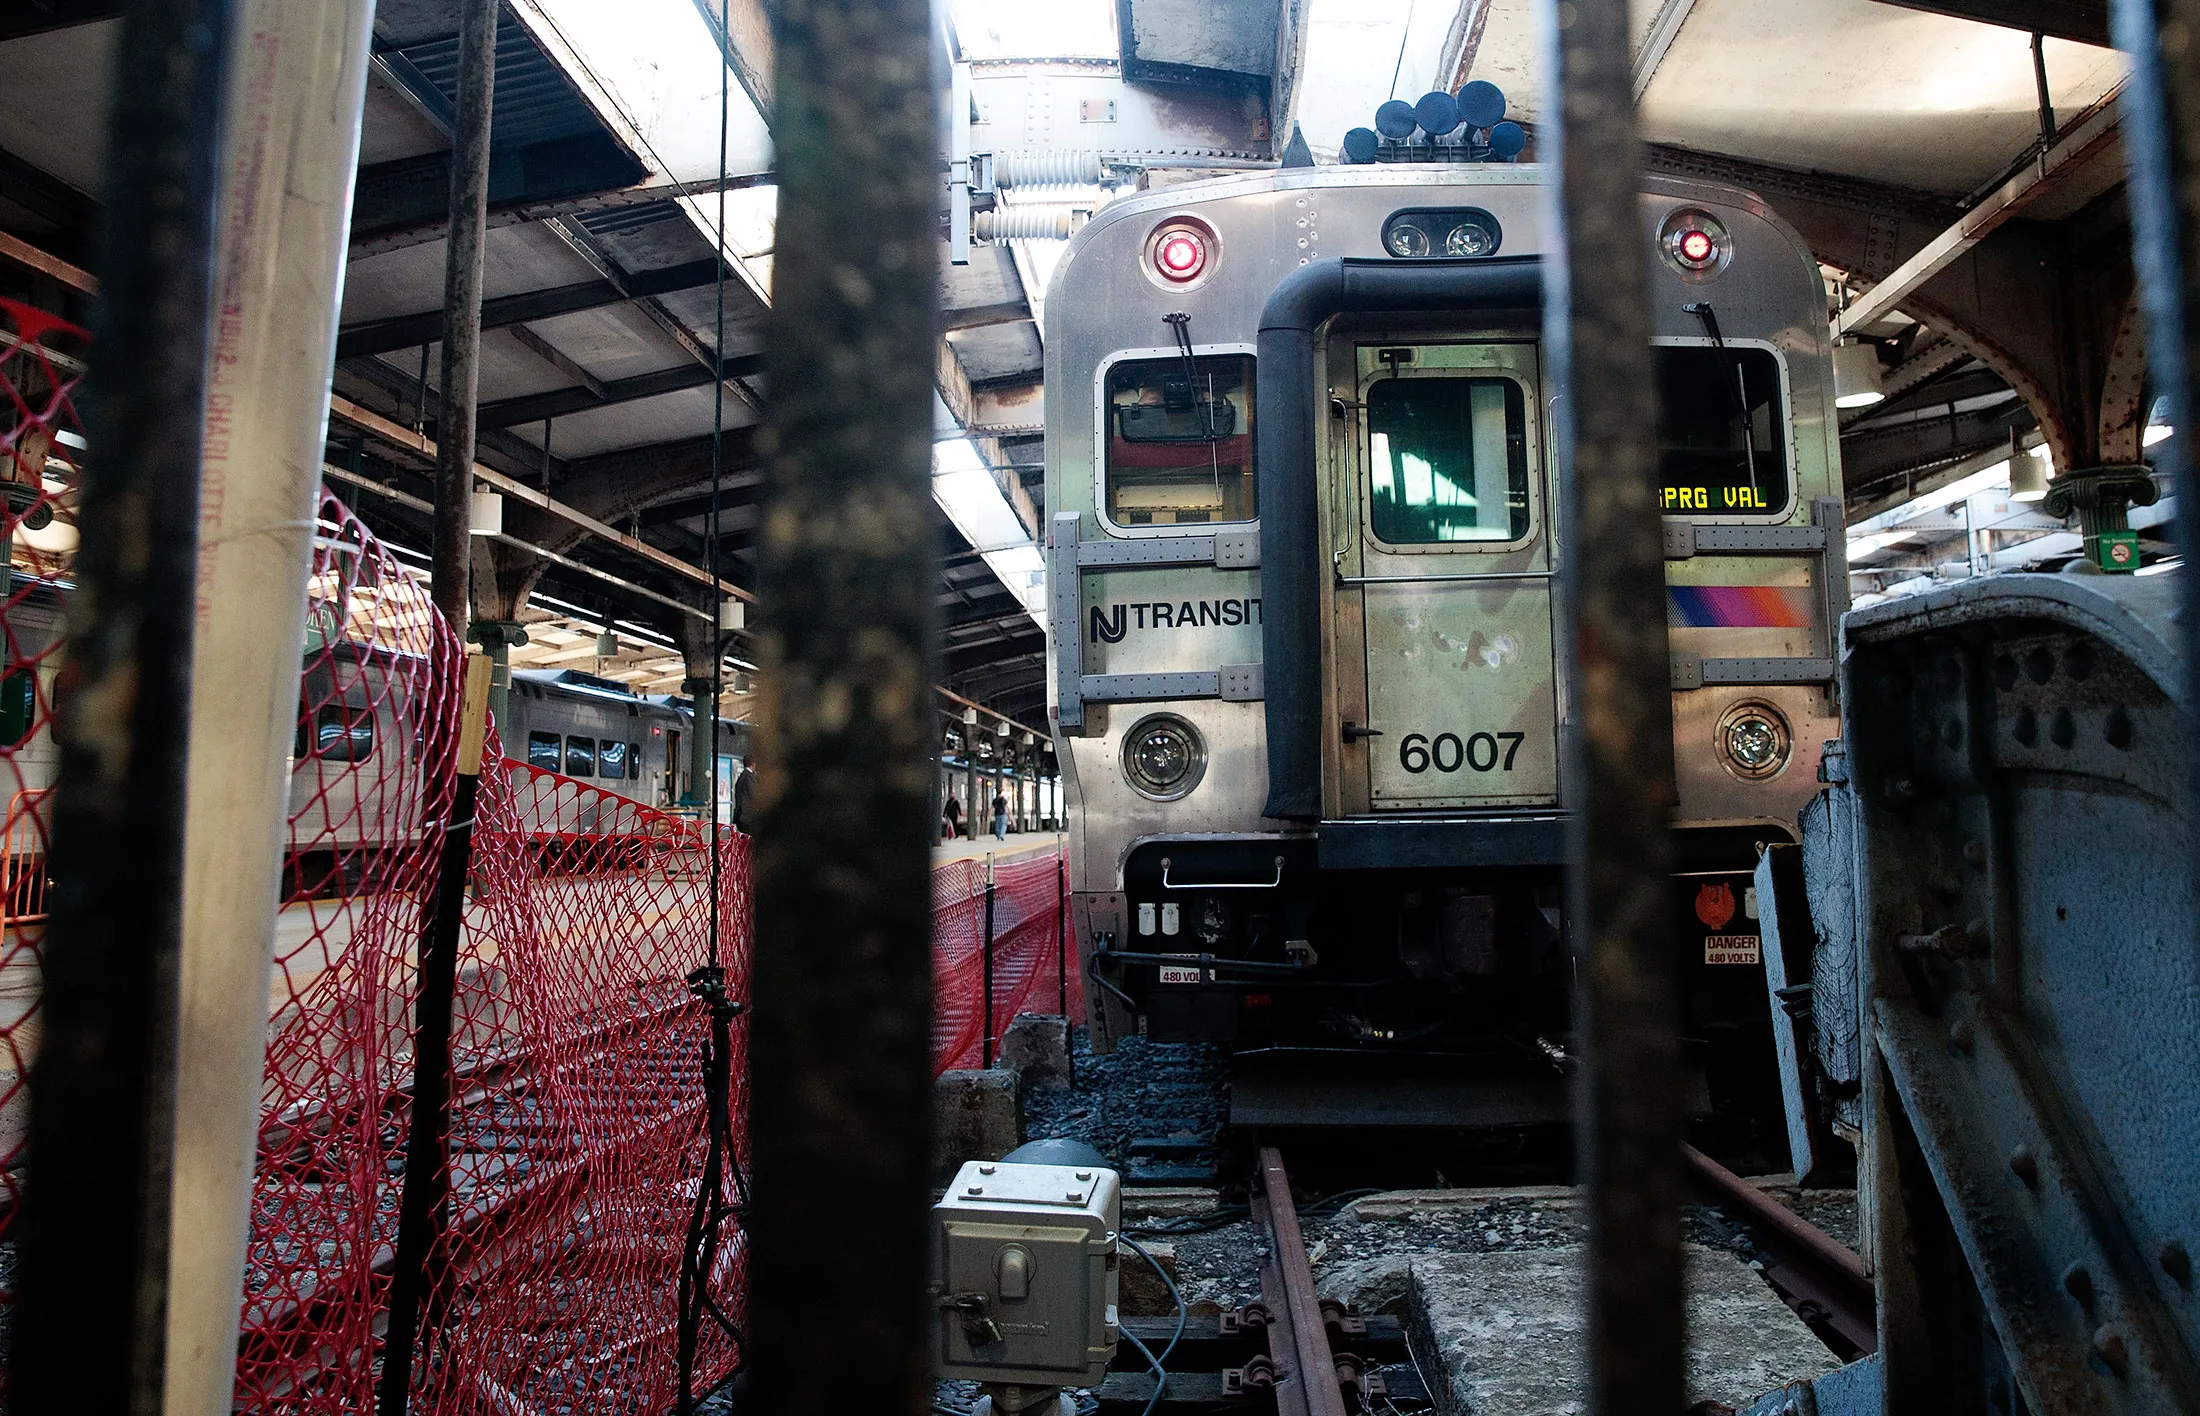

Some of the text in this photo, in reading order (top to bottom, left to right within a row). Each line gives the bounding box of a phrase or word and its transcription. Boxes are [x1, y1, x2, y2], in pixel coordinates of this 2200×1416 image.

[1724, 487, 1767, 508] VAL
[1400, 731, 1525, 773] 6007
[1708, 936, 1756, 949] DANGER
[1708, 953, 1756, 963] 480 VOLTS
[1163, 971, 1206, 982] 480 VOL
